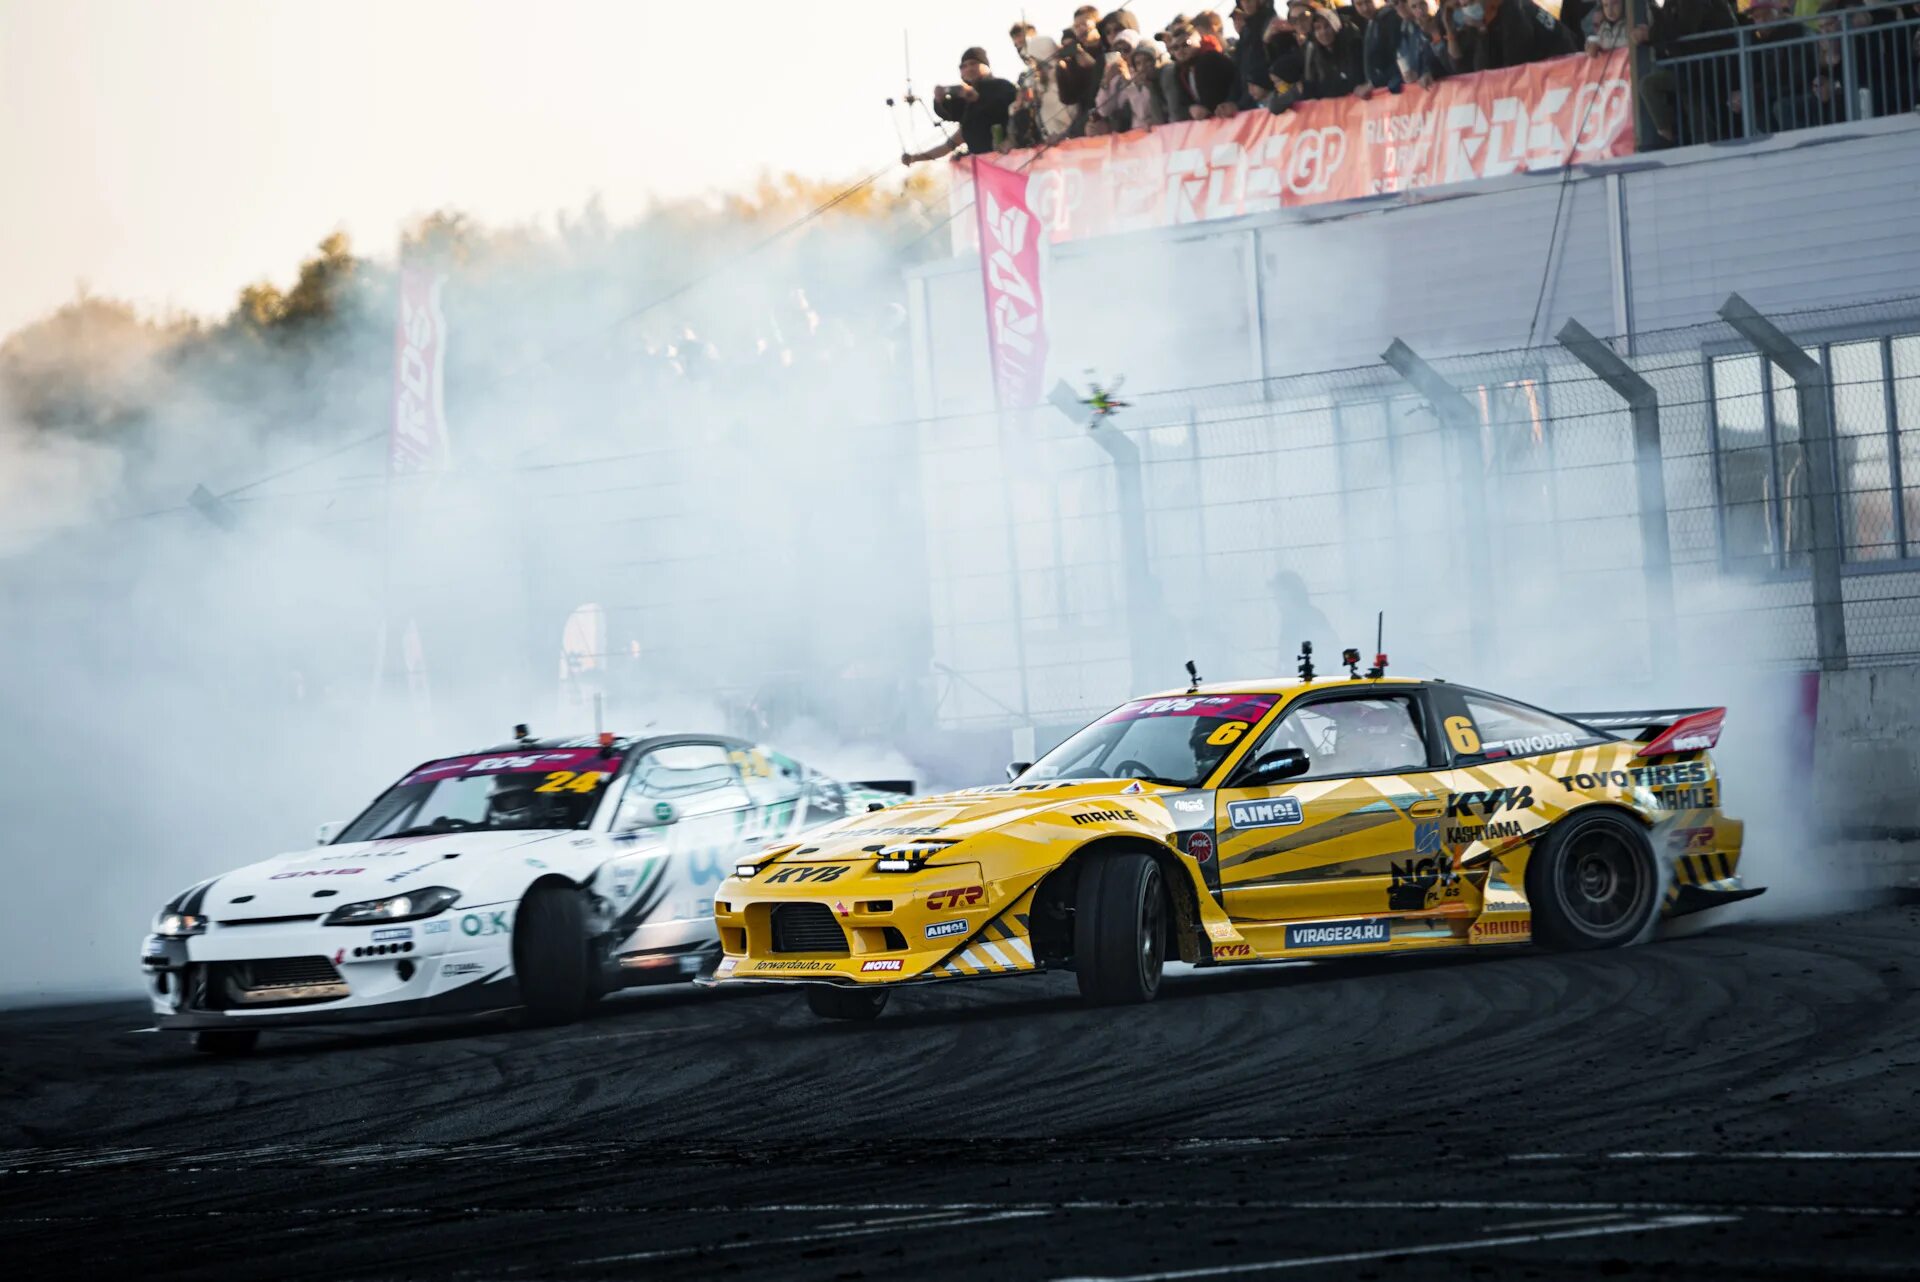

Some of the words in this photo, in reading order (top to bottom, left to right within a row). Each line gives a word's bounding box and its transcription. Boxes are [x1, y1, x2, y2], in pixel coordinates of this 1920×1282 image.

[1572, 79, 1630, 151] GP
[1287, 126, 1347, 195] GP
[986, 190, 1038, 356] RDS
[1206, 721, 1249, 746] 6
[1443, 715, 1481, 754] 6
[1504, 732, 1578, 756] TIVODAR
[533, 770, 601, 793] 24
[1558, 769, 1629, 792] TOYO
[1629, 762, 1708, 787] TIRES
[1235, 803, 1299, 824] AIMOL
[1447, 786, 1535, 818] KYB
[1070, 809, 1139, 826] MAHLE
[1447, 821, 1524, 844] KASHIYAMA
[764, 866, 850, 884] KYB
[1391, 856, 1461, 887] NGK
[926, 885, 984, 910] CTR
[927, 921, 966, 937] AIMOL
[1293, 925, 1385, 945] VIRAGE24.RU
[1213, 944, 1250, 958] KYB
[754, 959, 836, 971] forwardauto.ru
[862, 960, 901, 971] MOTUL
